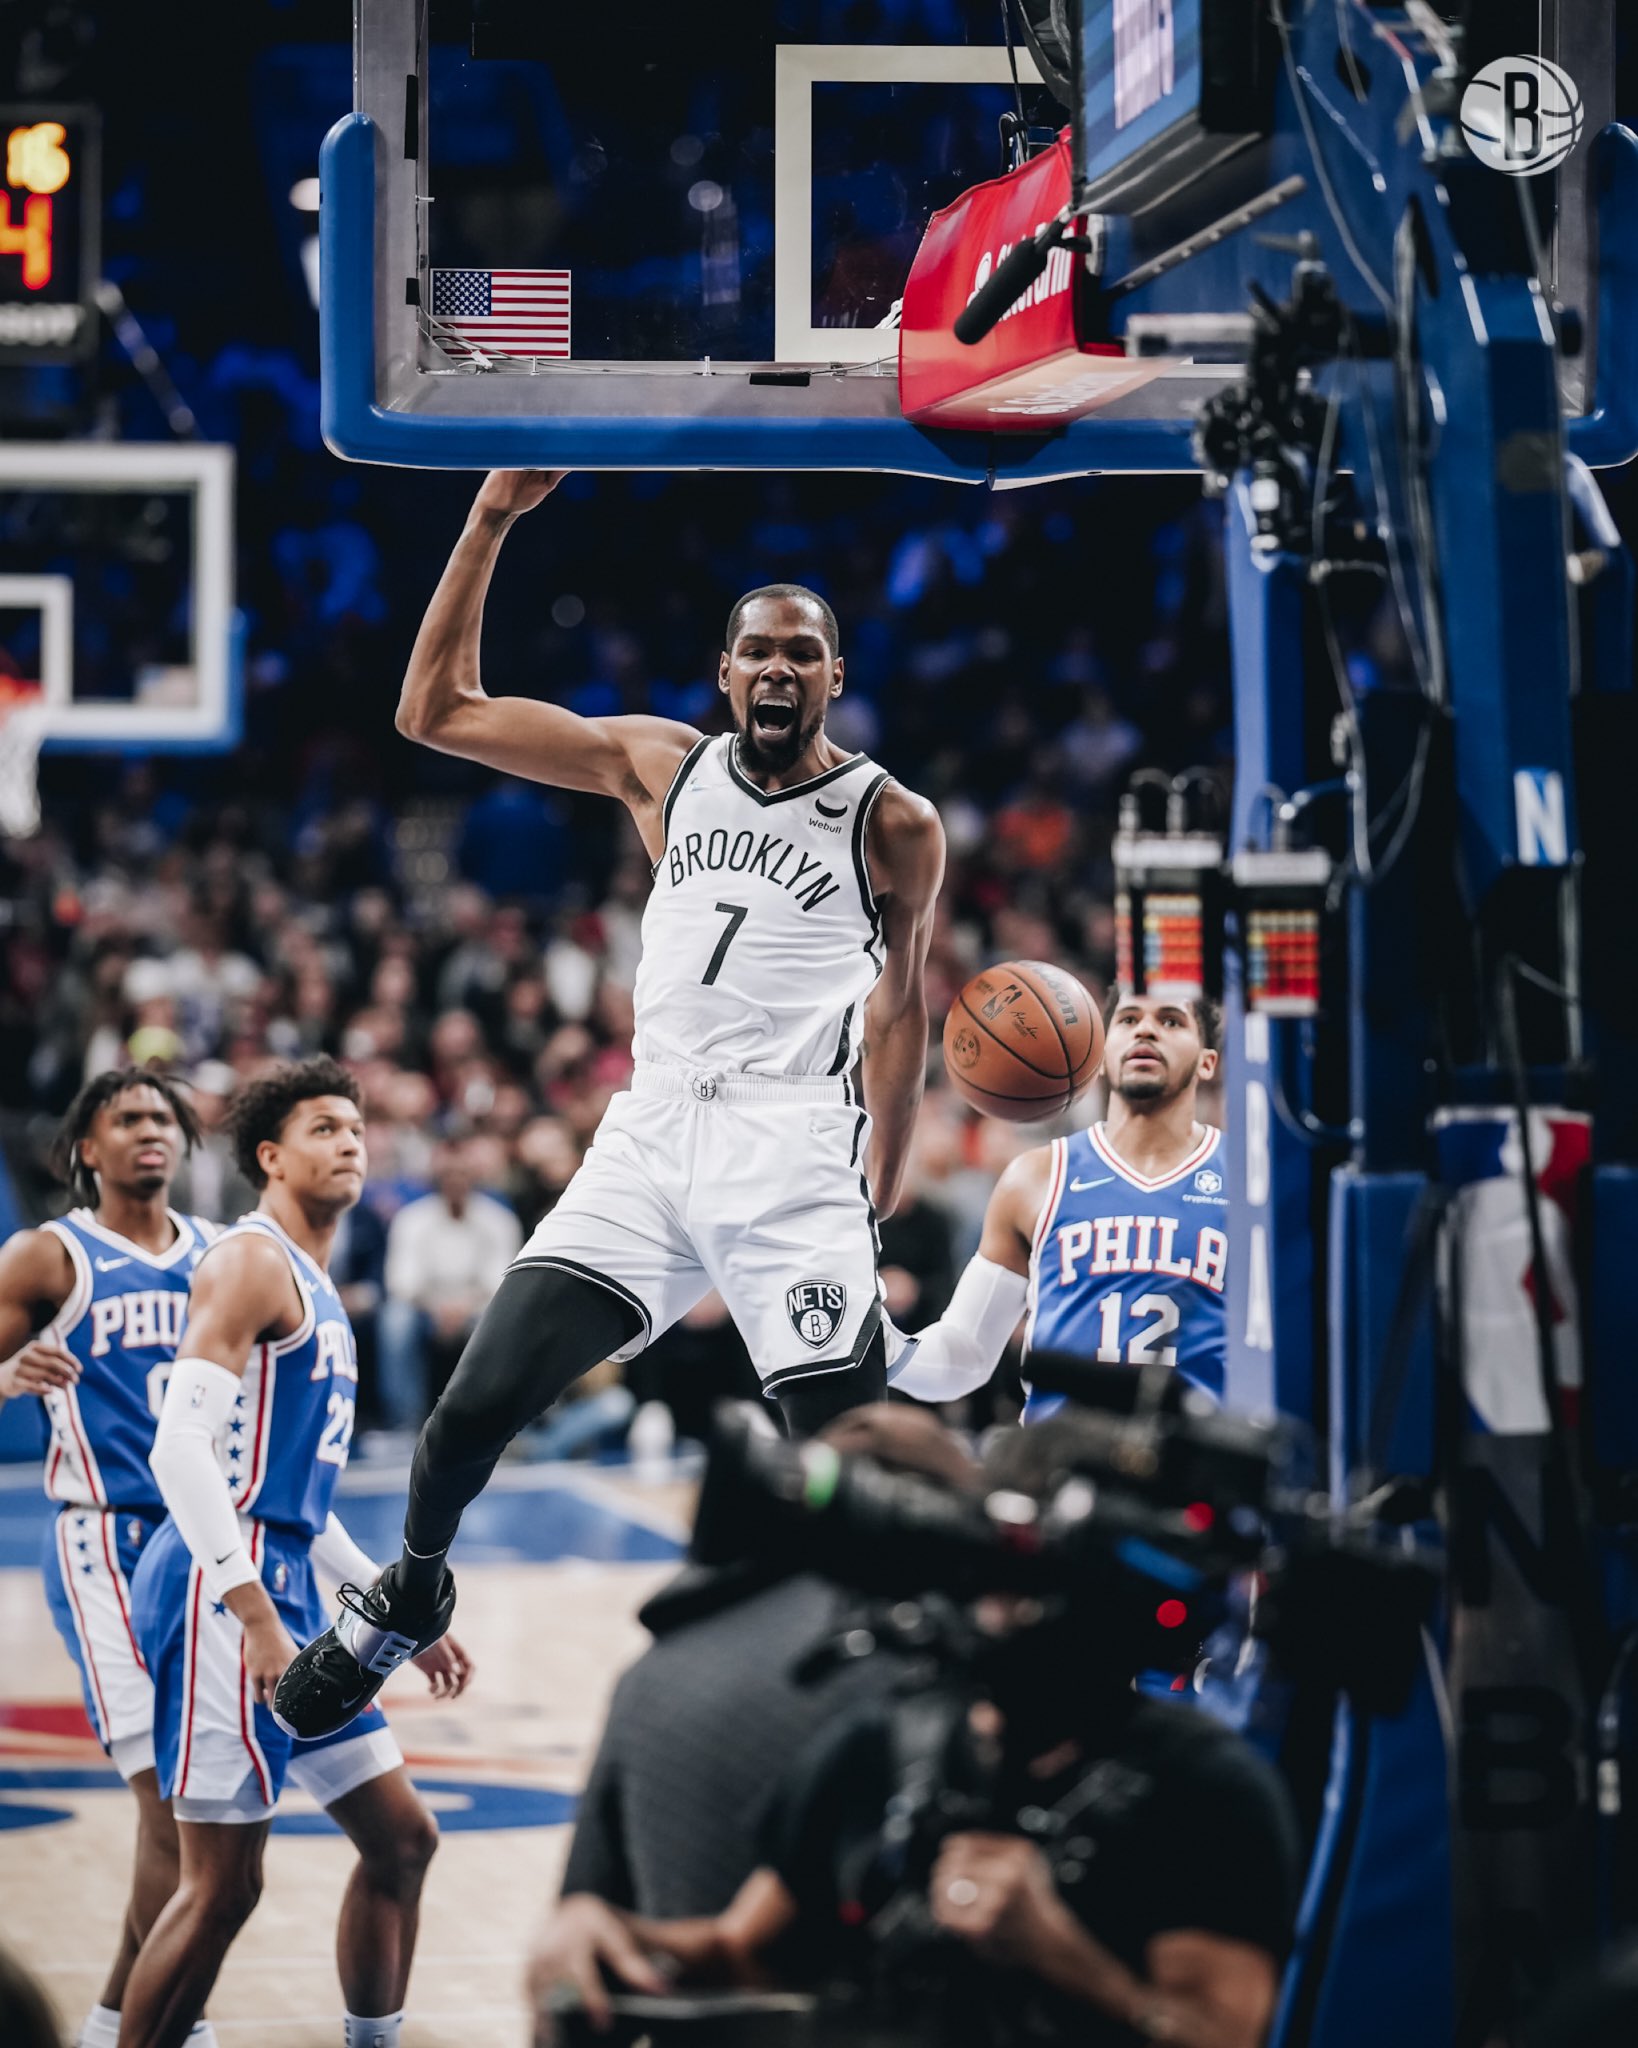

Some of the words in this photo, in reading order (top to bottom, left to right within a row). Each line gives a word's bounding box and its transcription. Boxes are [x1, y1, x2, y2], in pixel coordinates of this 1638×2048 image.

[809, 818, 842, 834] Webull
[670, 829, 840, 912] BROOKLYN
[701, 901, 748, 986] 7
[1058, 1215, 1229, 1293] PHILA
[788, 1283, 842, 1316] NETS
[810, 1314, 822, 1337] B
[1097, 1292, 1180, 1367] 12
